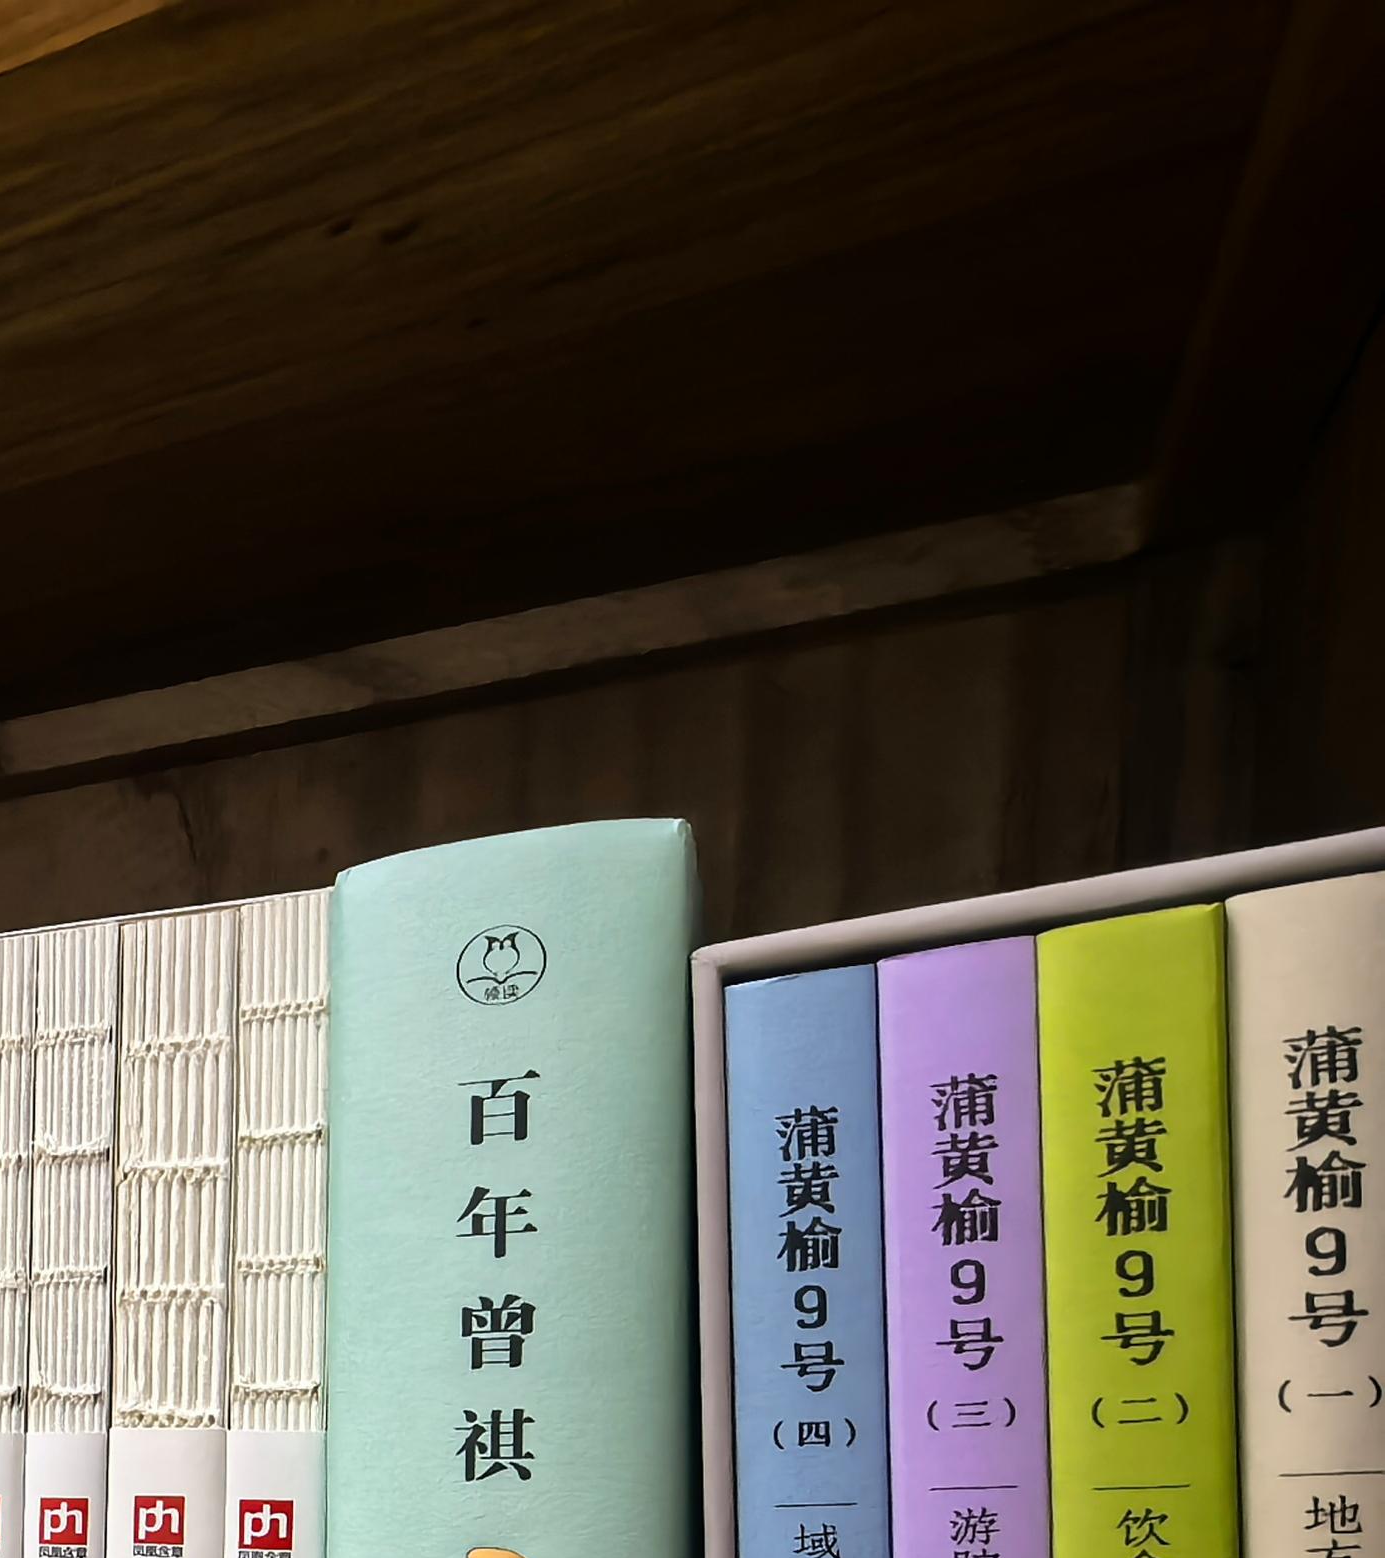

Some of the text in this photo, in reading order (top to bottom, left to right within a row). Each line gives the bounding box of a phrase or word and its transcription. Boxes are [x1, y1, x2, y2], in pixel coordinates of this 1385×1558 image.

[454, 1069, 541, 1483] 百年曾祺
[774, 1104, 845, 1393] 蒲黄榆9号
[929, 1072, 1005, 1372] 蒲黄榆9号
[1091, 1055, 1176, 1367] 蒲黄榆9号
[1282, 1025, 1371, 1348] 蒲黄榆9号
